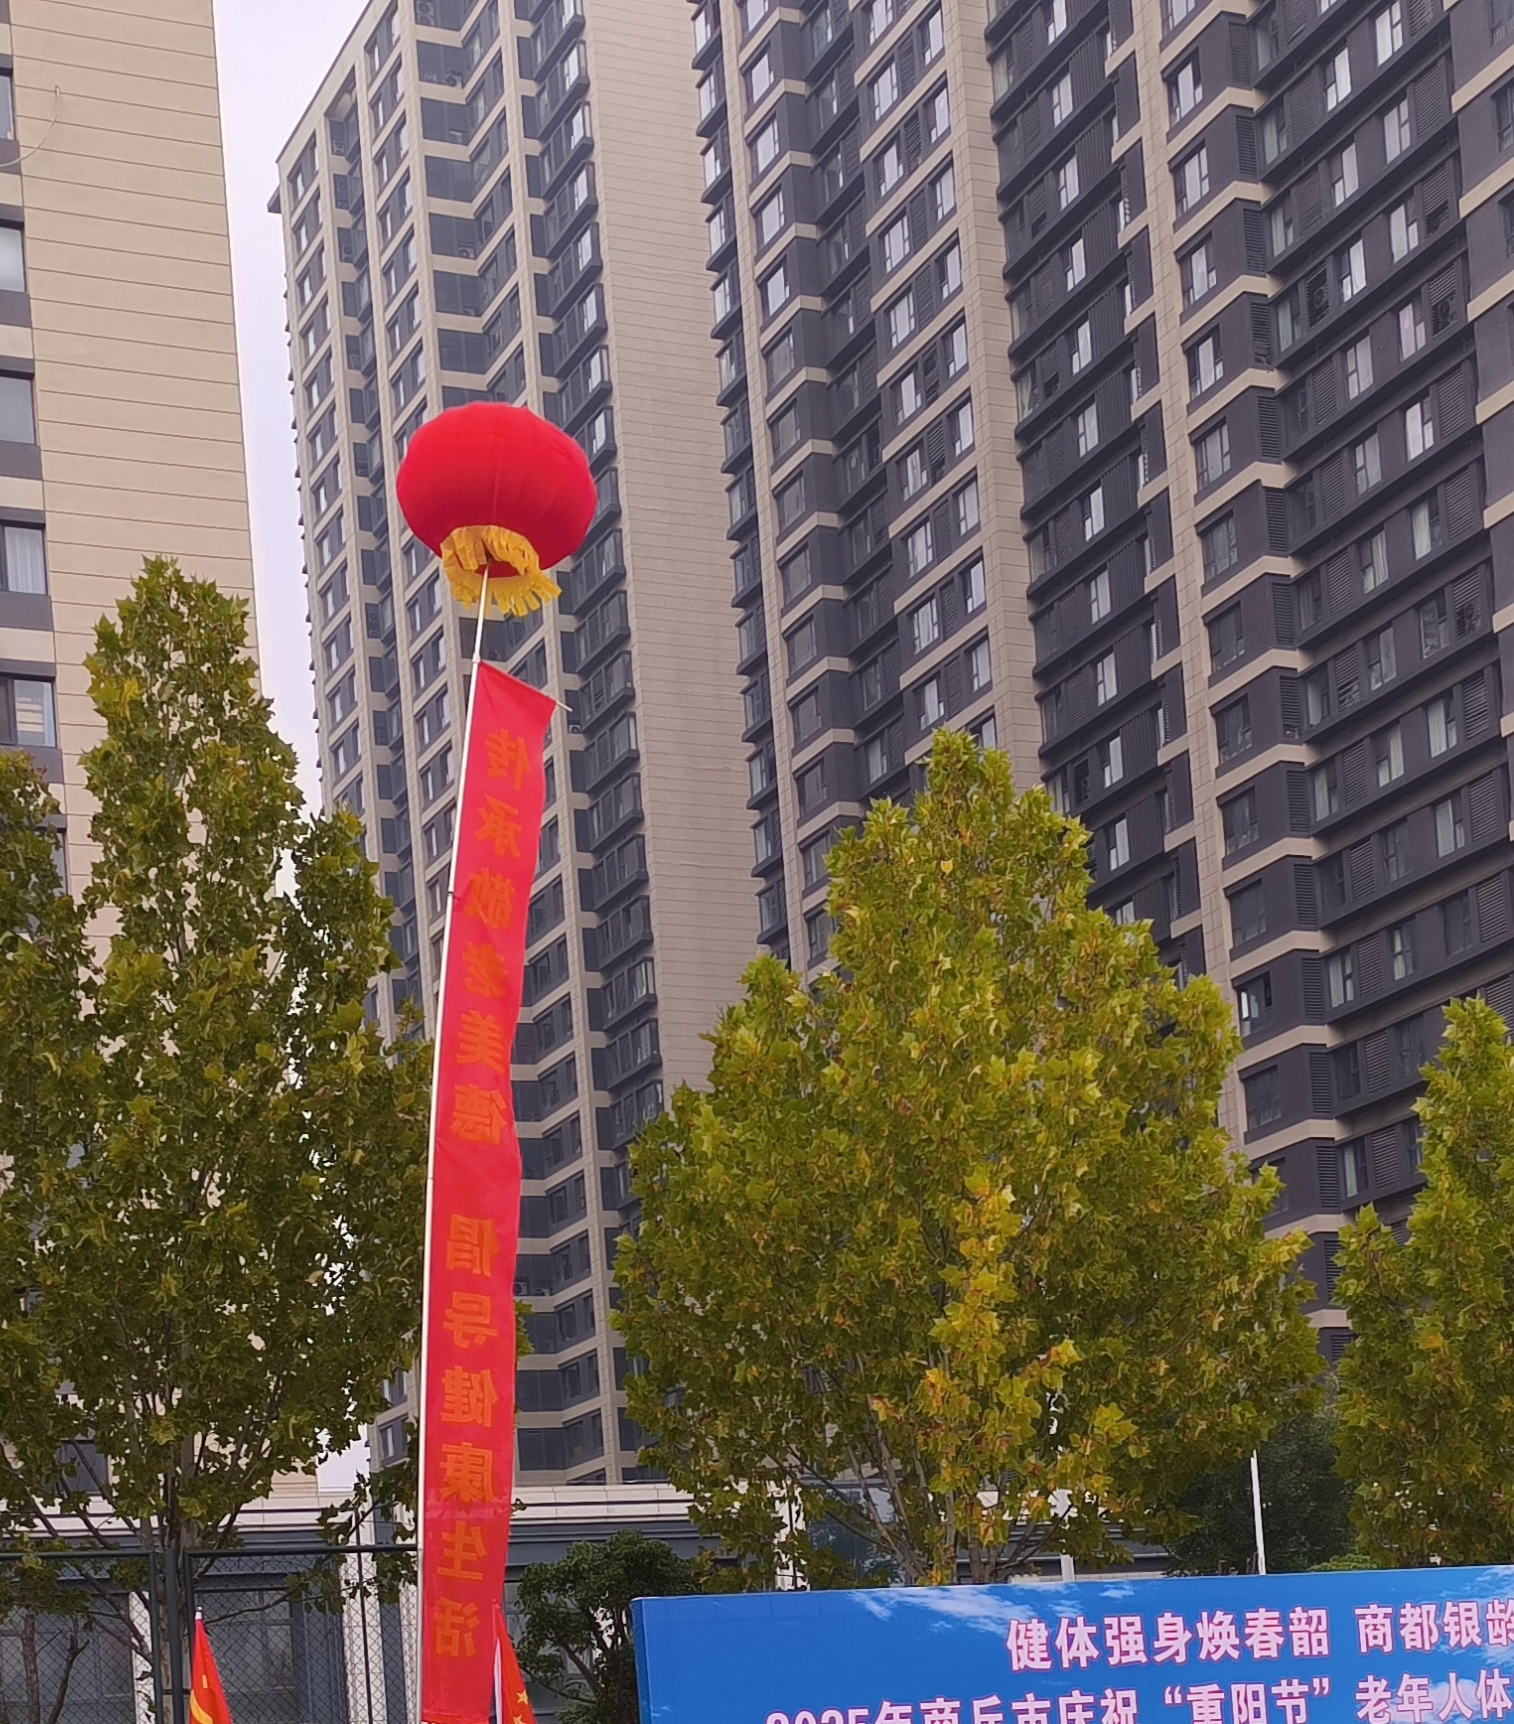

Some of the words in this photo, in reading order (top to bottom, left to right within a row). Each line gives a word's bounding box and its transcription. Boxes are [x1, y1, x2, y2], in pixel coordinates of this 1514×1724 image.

[1006, 1606, 1330, 1672] 健体强身焕春韶
